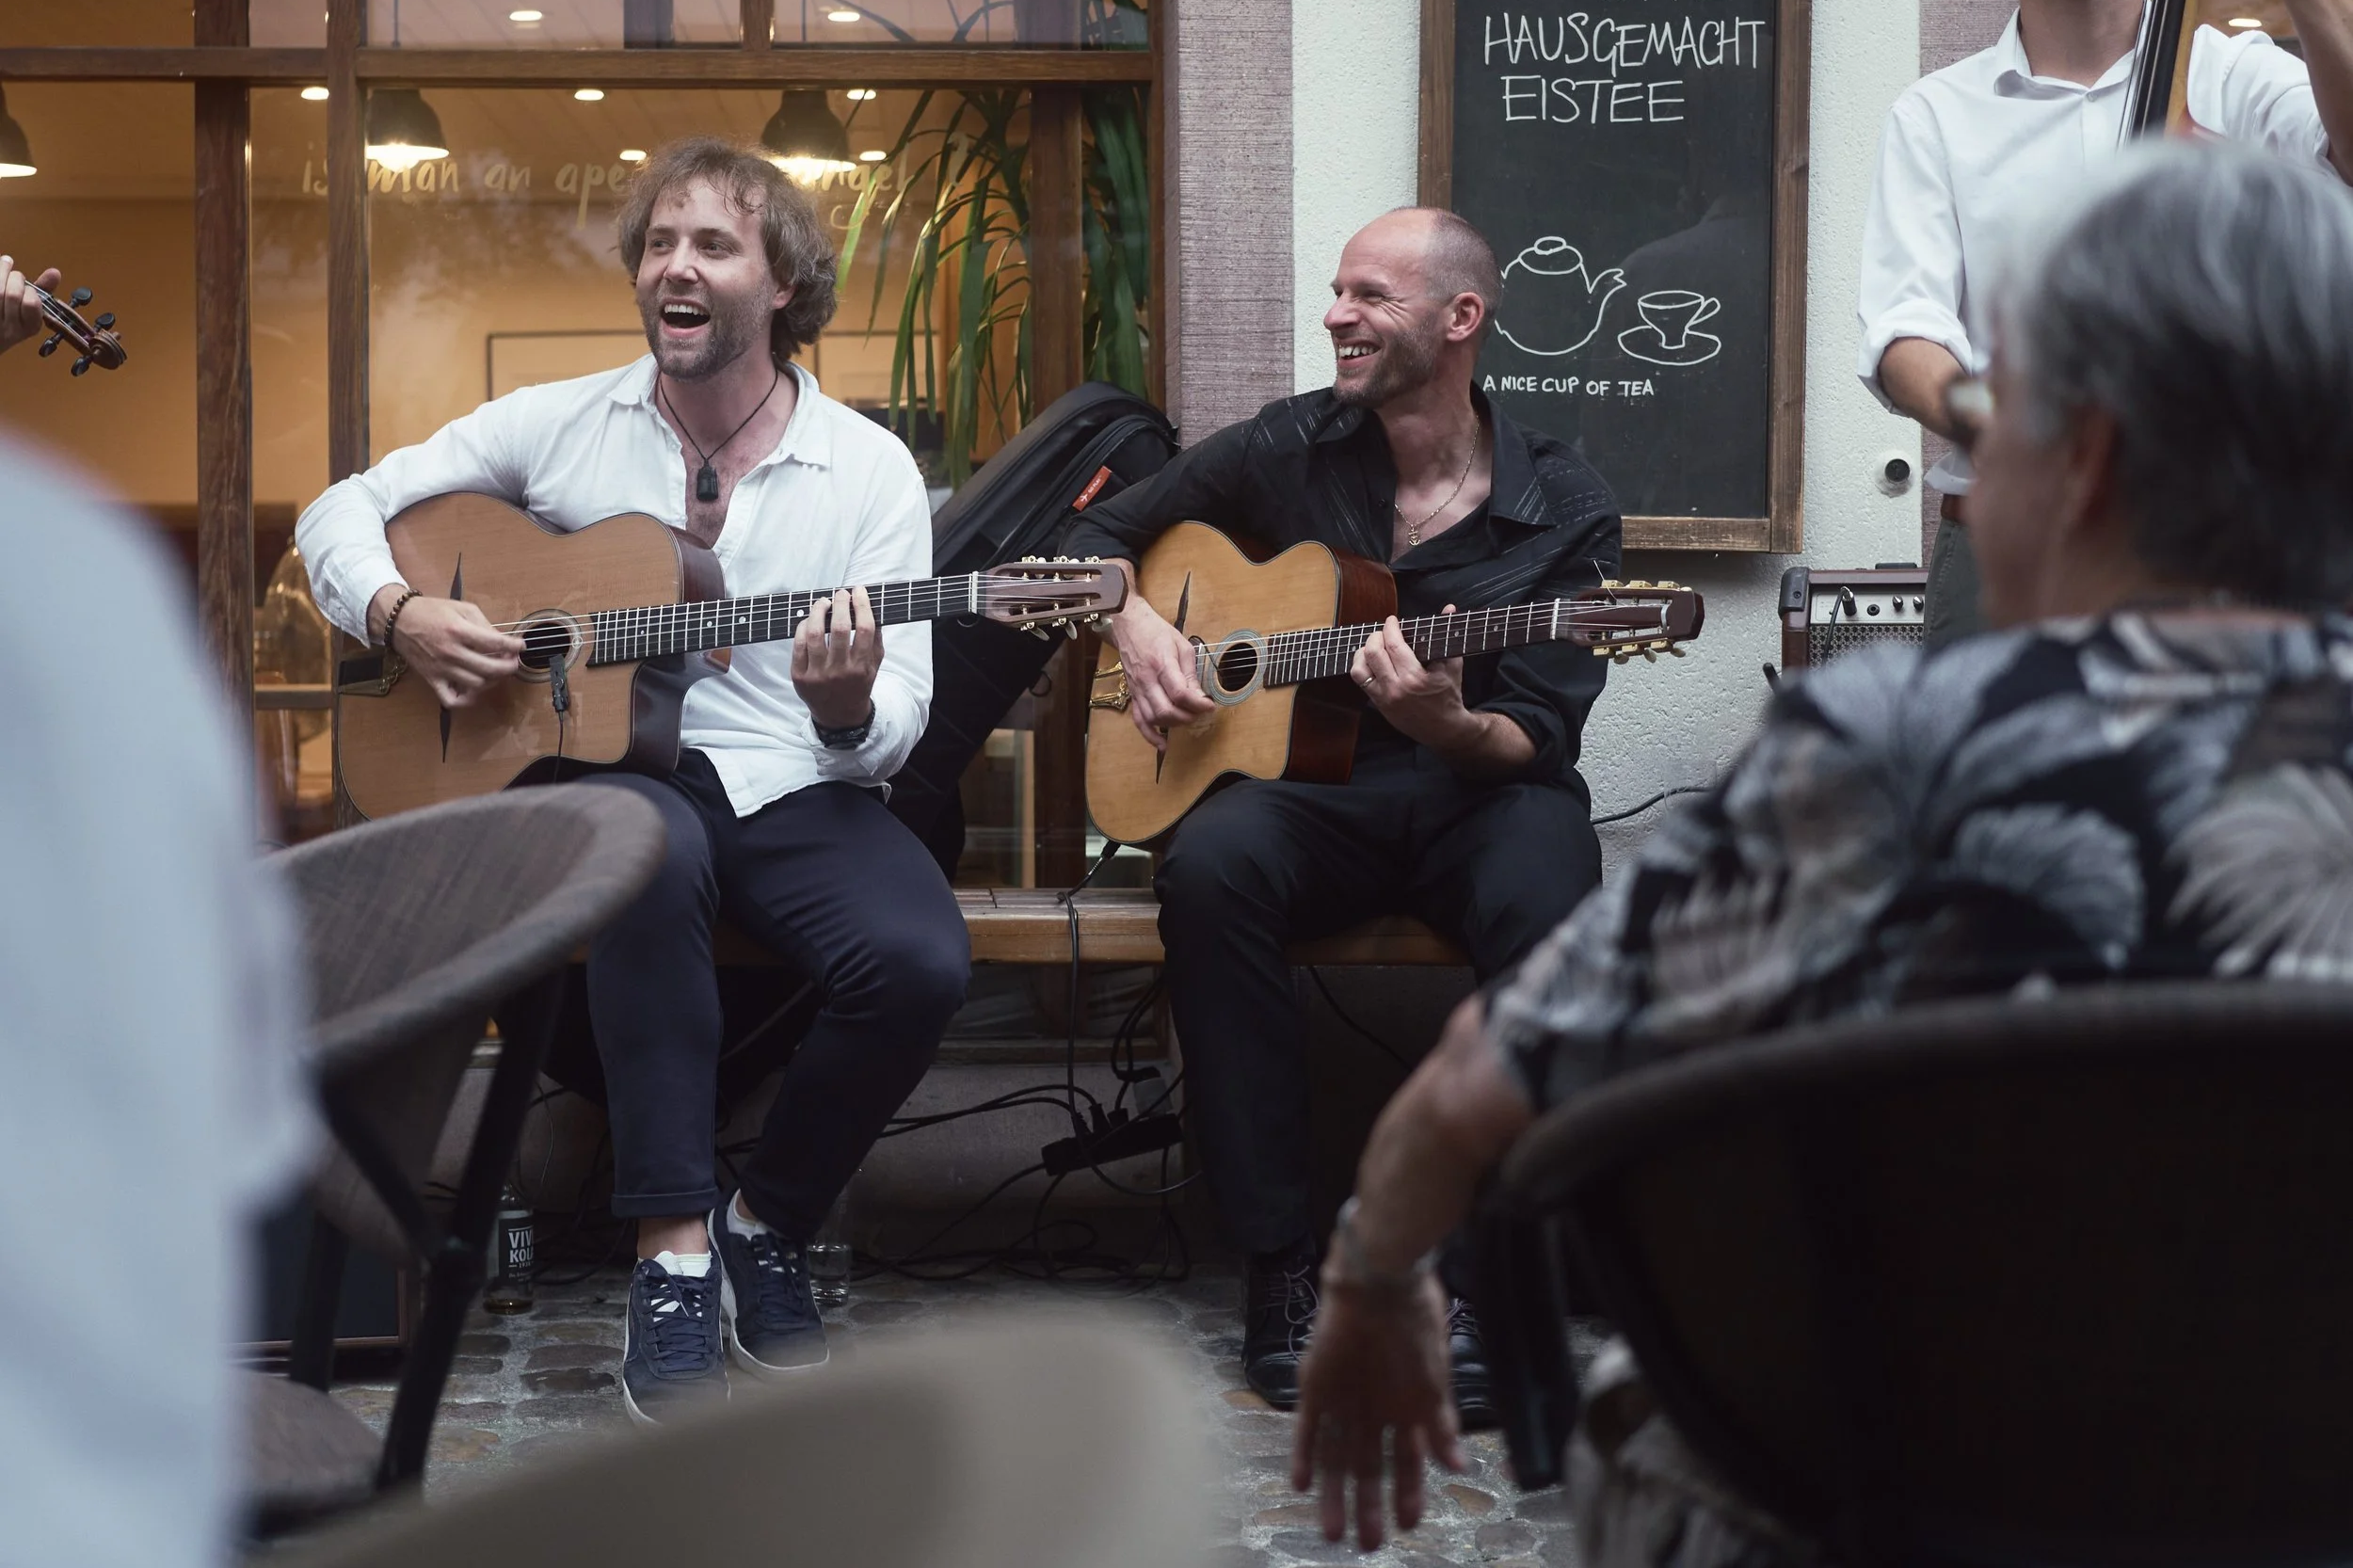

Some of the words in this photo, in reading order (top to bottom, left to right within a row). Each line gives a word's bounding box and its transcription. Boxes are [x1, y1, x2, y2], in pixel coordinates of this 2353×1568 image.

[1484, 12, 1766, 77] HAUSGEMACHT
[1501, 75, 1685, 123] EISTEE
[366, 158, 459, 195] man
[484, 163, 530, 193] an
[809, 142, 910, 230] ngel
[1482, 375, 1497, 392] A
[1500, 376, 1537, 392] NICE
[1542, 376, 1579, 393] CUP
[1586, 380, 1610, 396] OF
[1617, 378, 1655, 397] TEA
